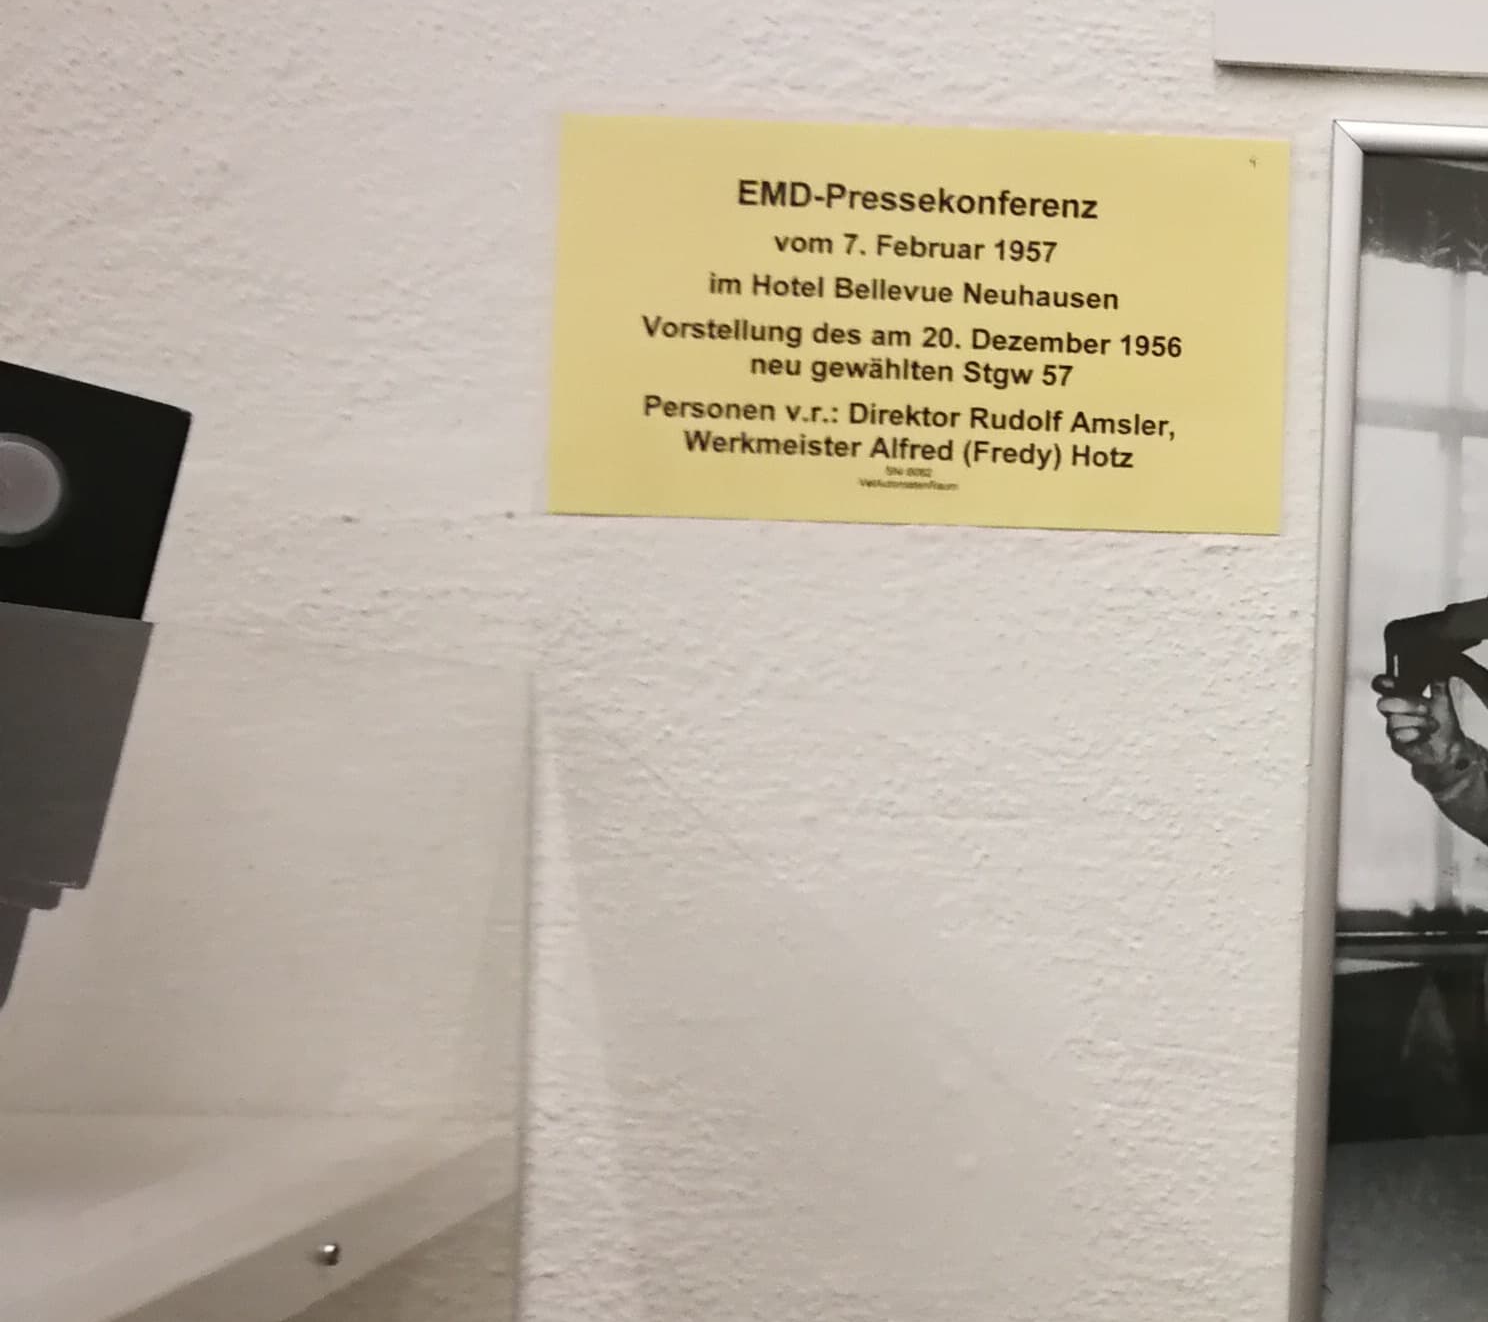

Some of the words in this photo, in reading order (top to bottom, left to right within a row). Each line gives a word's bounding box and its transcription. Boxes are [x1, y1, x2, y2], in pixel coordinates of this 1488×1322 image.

[737, 178, 1099, 220] EMD-Pressekonferenz
[773, 235, 834, 255] vom
[842, 232, 867, 256] 7.
[876, 233, 986, 261] Februar
[993, 238, 1058, 264] 1957
[709, 271, 743, 296] im
[751, 273, 825, 299] Hotel
[833, 276, 954, 304] Bellevue
[962, 281, 1119, 311] Neuhausen
[641, 314, 803, 350] Vorstellung
[811, 321, 863, 346] des
[870, 328, 912, 348] am
[921, 326, 962, 350] 20.
[971, 327, 1112, 356] Dezember
[1119, 333, 1183, 359] 1956
[749, 357, 802, 377] neu
[810, 356, 954, 384] gewählten
[962, 360, 1035, 391] Stgw
[1041, 363, 1075, 387] 57
[643, 394, 777, 422] Personen
[784, 404, 839, 424] v.r.:
[848, 401, 963, 429] Direktor
[969, 406, 1065, 433] Rudolf
[1069, 410, 1176, 442] Amsler,
[682, 429, 863, 458] Werkmeister
[868, 436, 954, 462] Alfred
[962, 439, 1063, 472] (Fredy)
[1071, 443, 1135, 469] Hotz
